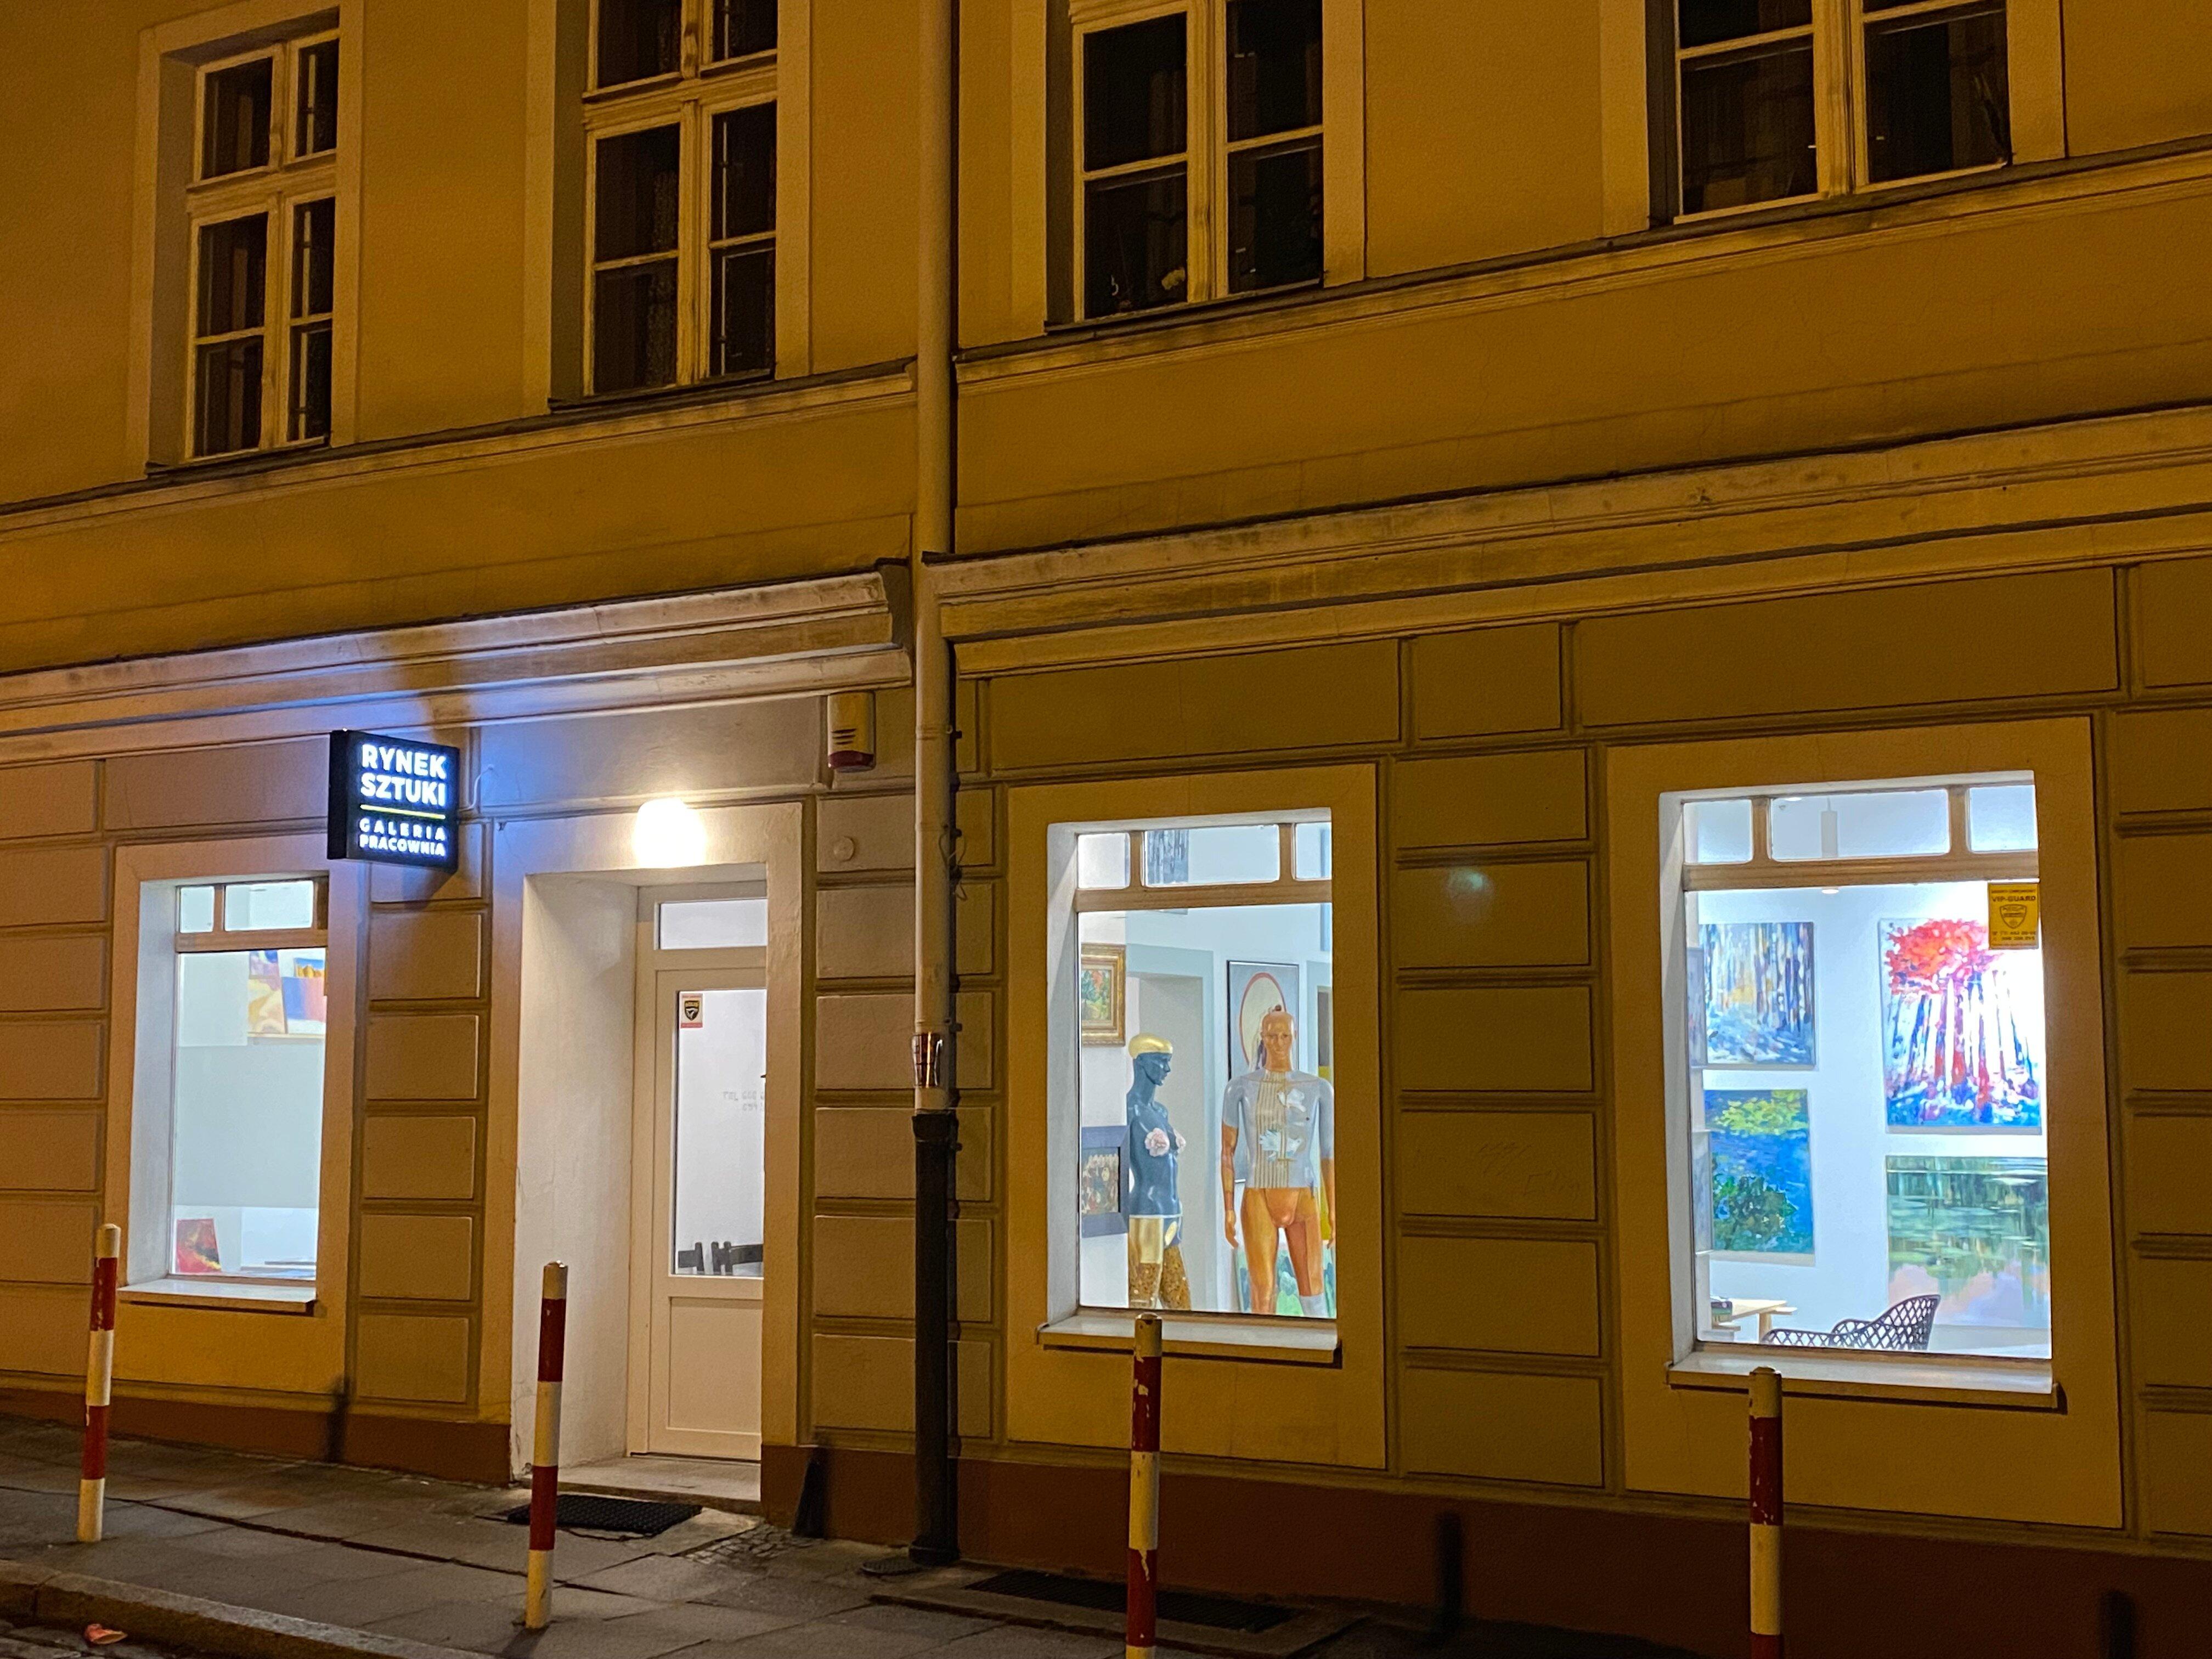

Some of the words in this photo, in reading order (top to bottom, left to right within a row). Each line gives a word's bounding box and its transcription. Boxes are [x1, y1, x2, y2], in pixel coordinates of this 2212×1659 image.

[362, 743, 447, 780] RYNEK
[360, 772, 446, 807] SZTUKI
[359, 817, 446, 841] GALERIA
[359, 834, 446, 857] PRACOWNIA
